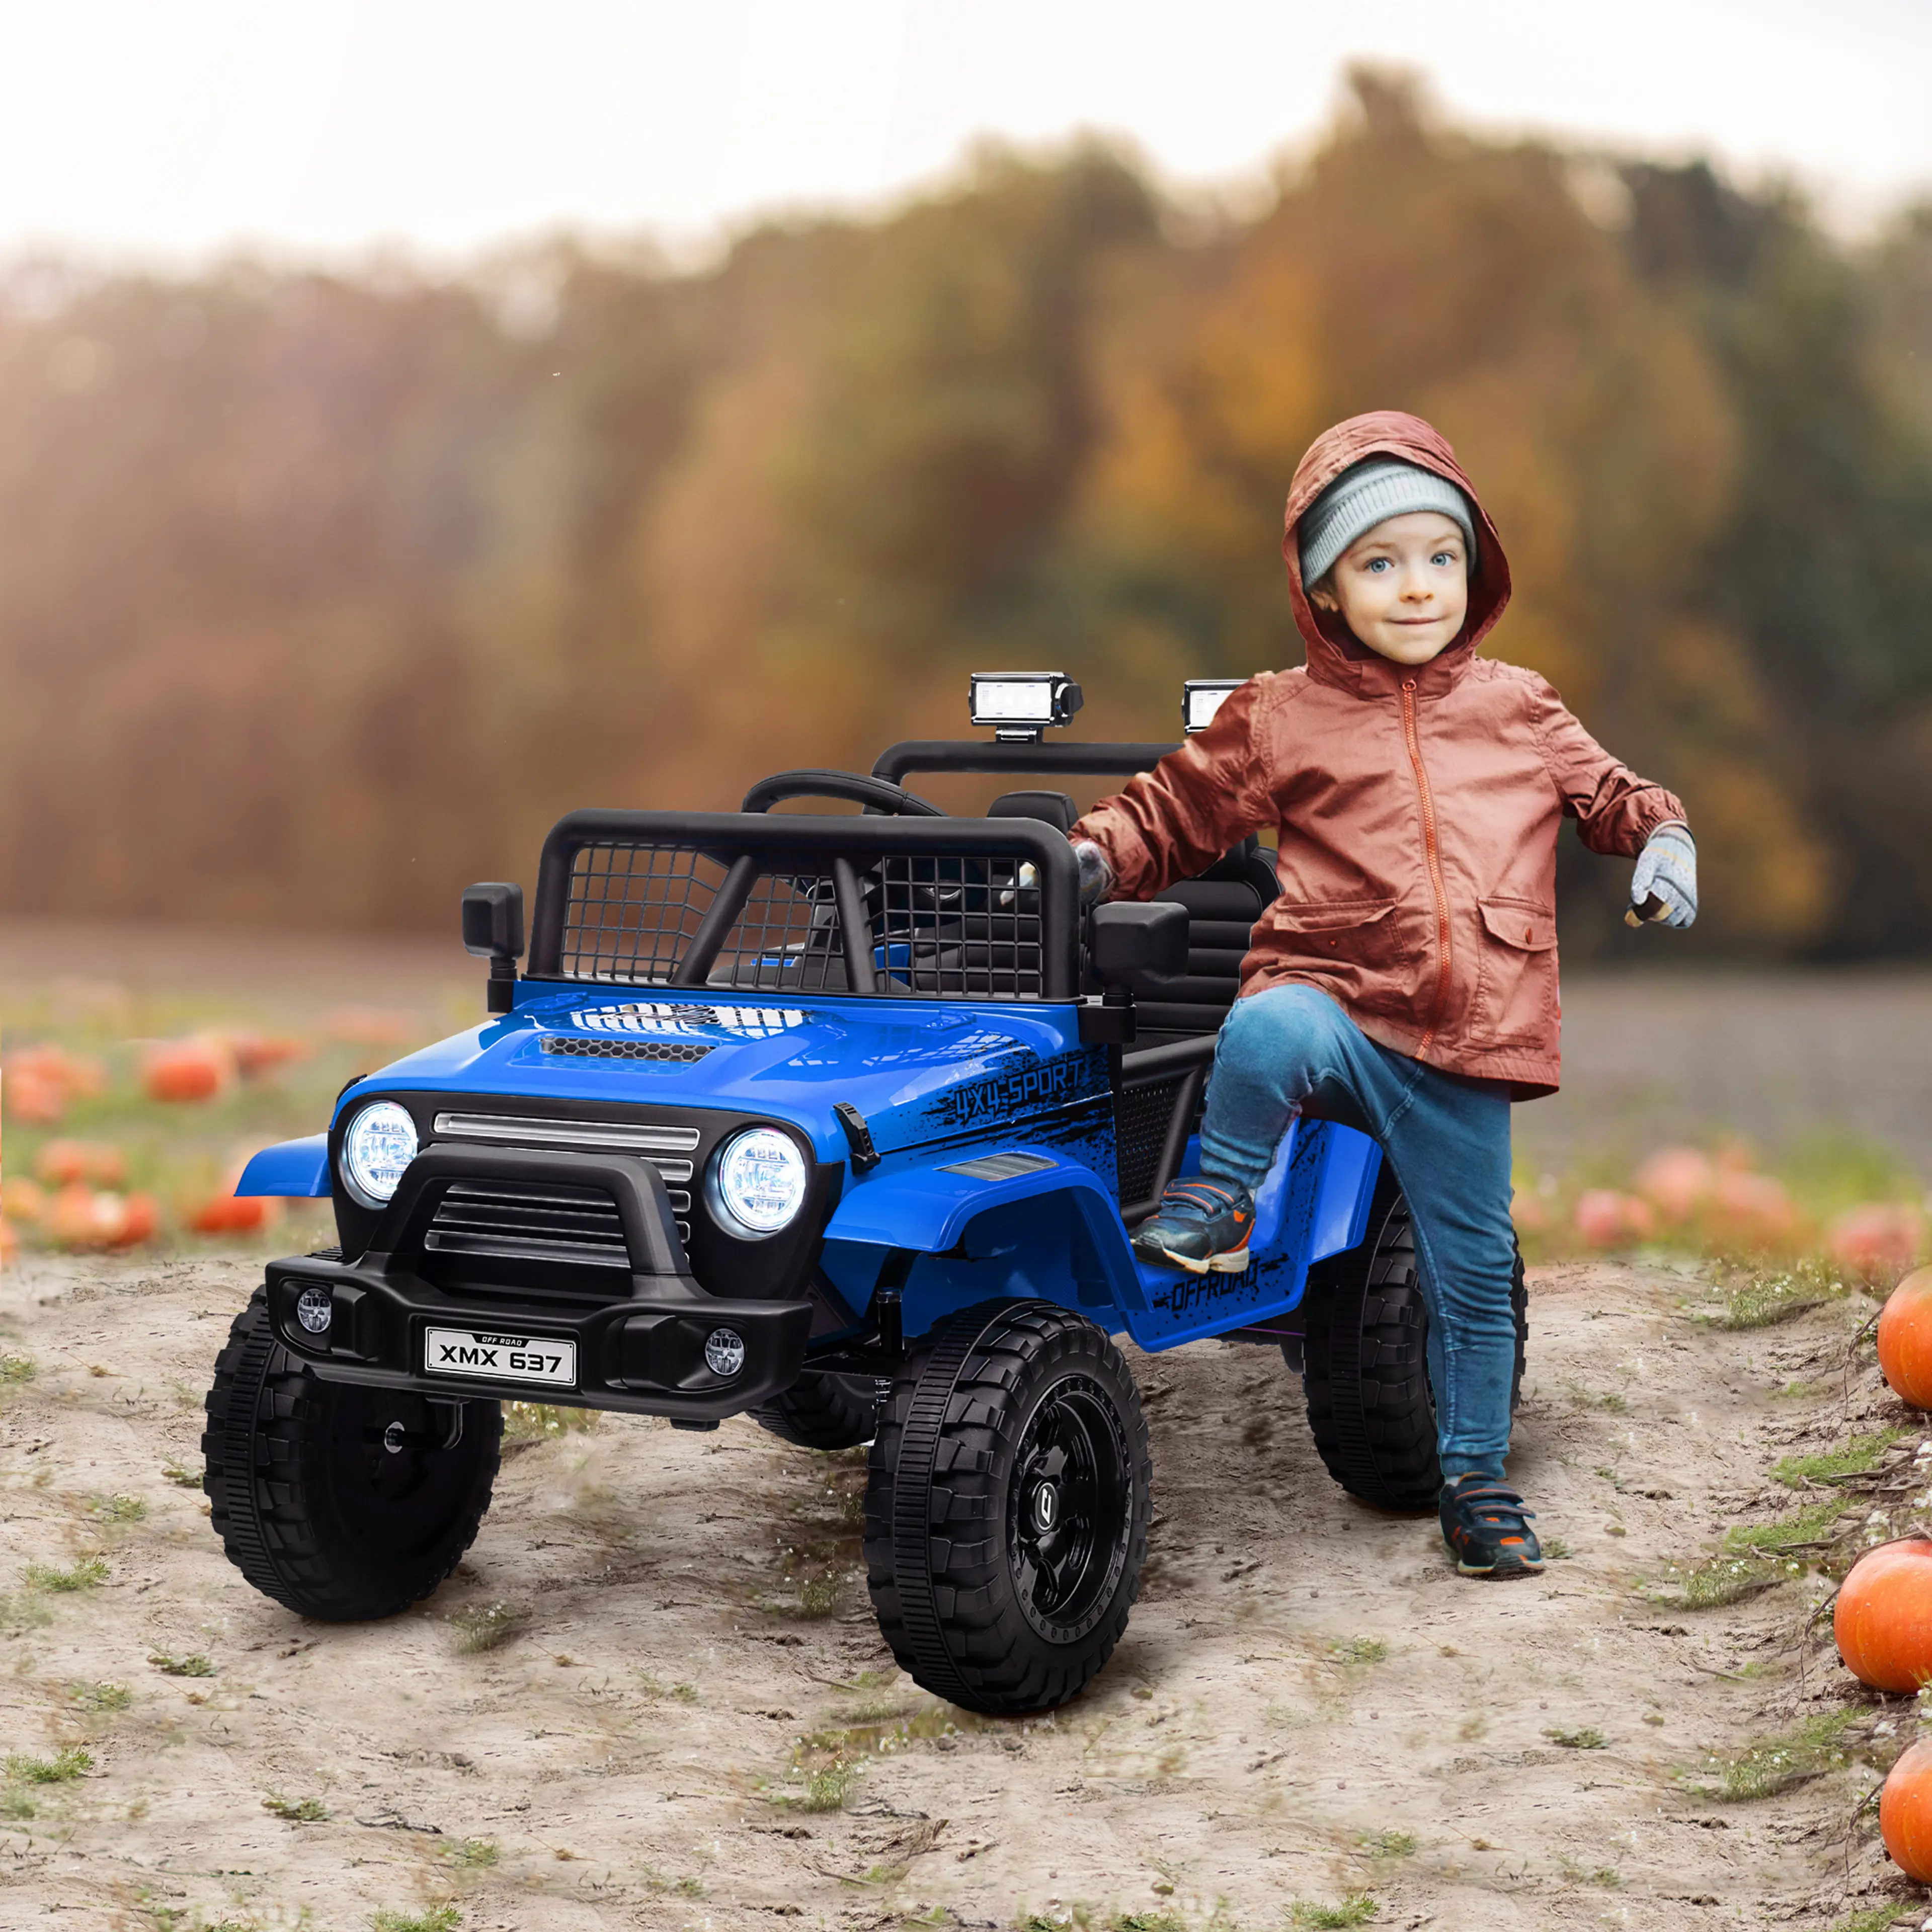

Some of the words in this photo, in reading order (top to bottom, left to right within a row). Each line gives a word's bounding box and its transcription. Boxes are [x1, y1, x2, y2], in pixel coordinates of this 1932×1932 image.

[481, 1336, 498, 1344] OFF
[500, 1338, 522, 1346] ROAD
[439, 1344, 498, 1366] XMX
[509, 1352, 562, 1373] 637
